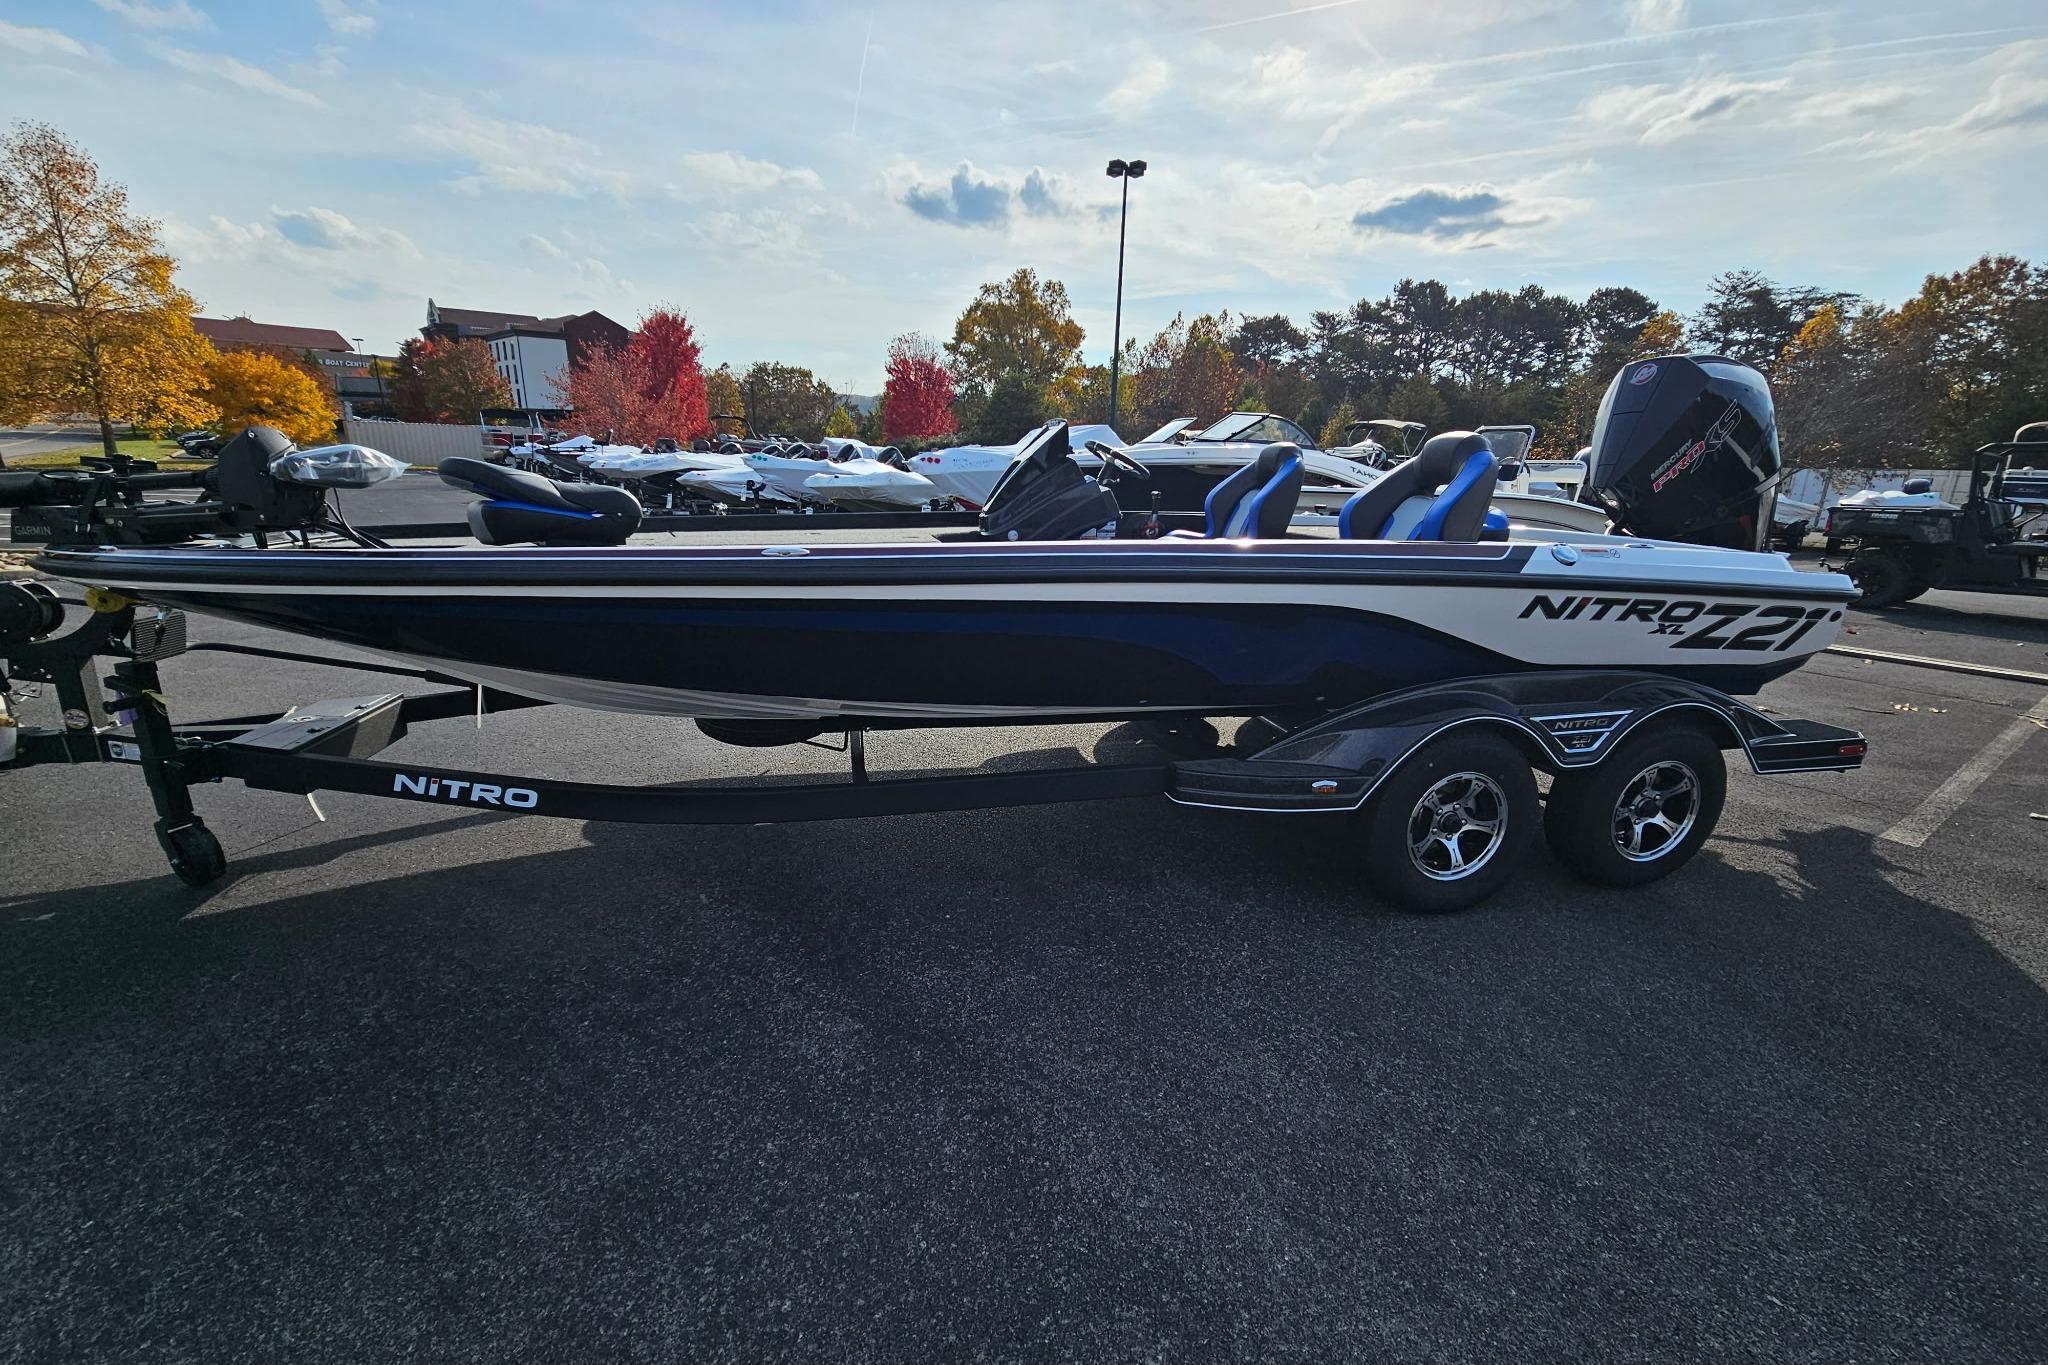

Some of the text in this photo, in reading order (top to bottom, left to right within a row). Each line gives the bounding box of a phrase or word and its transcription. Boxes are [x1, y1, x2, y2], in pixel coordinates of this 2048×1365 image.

[1650, 438, 1692, 481] MERCURY
[1652, 440, 1706, 493] PRO
[1350, 465, 1379, 481] TAHO
[14, 525, 52, 537] GARMIN
[1516, 594, 1832, 652] NITRO Z21
[1647, 622, 1688, 636] XL
[1554, 718, 1609, 730] NITRO
